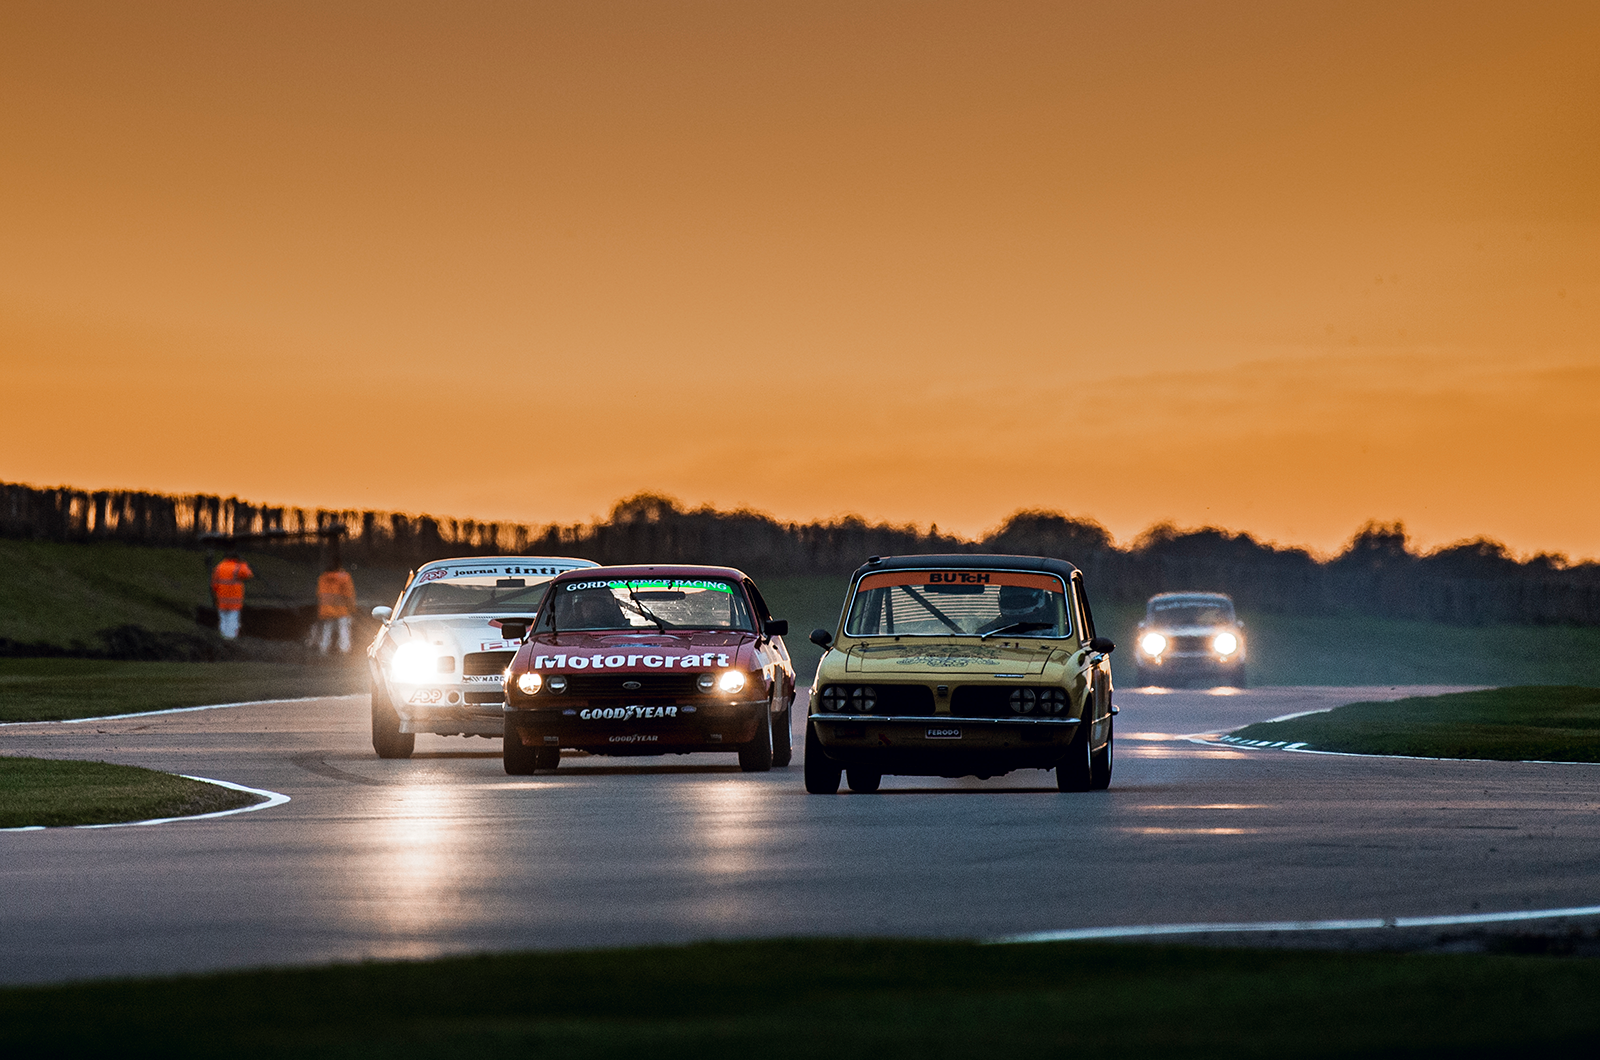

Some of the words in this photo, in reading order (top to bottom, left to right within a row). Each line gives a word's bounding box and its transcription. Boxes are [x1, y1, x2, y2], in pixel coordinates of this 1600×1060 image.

[453, 568, 498, 576] journal
[566, 580, 628, 591] GORDON
[674, 579, 728, 591] RACING
[534, 653, 729, 669] Motorcraft
[579, 704, 678, 721] GOODYEAR
[609, 734, 659, 743] GOODYEAR
